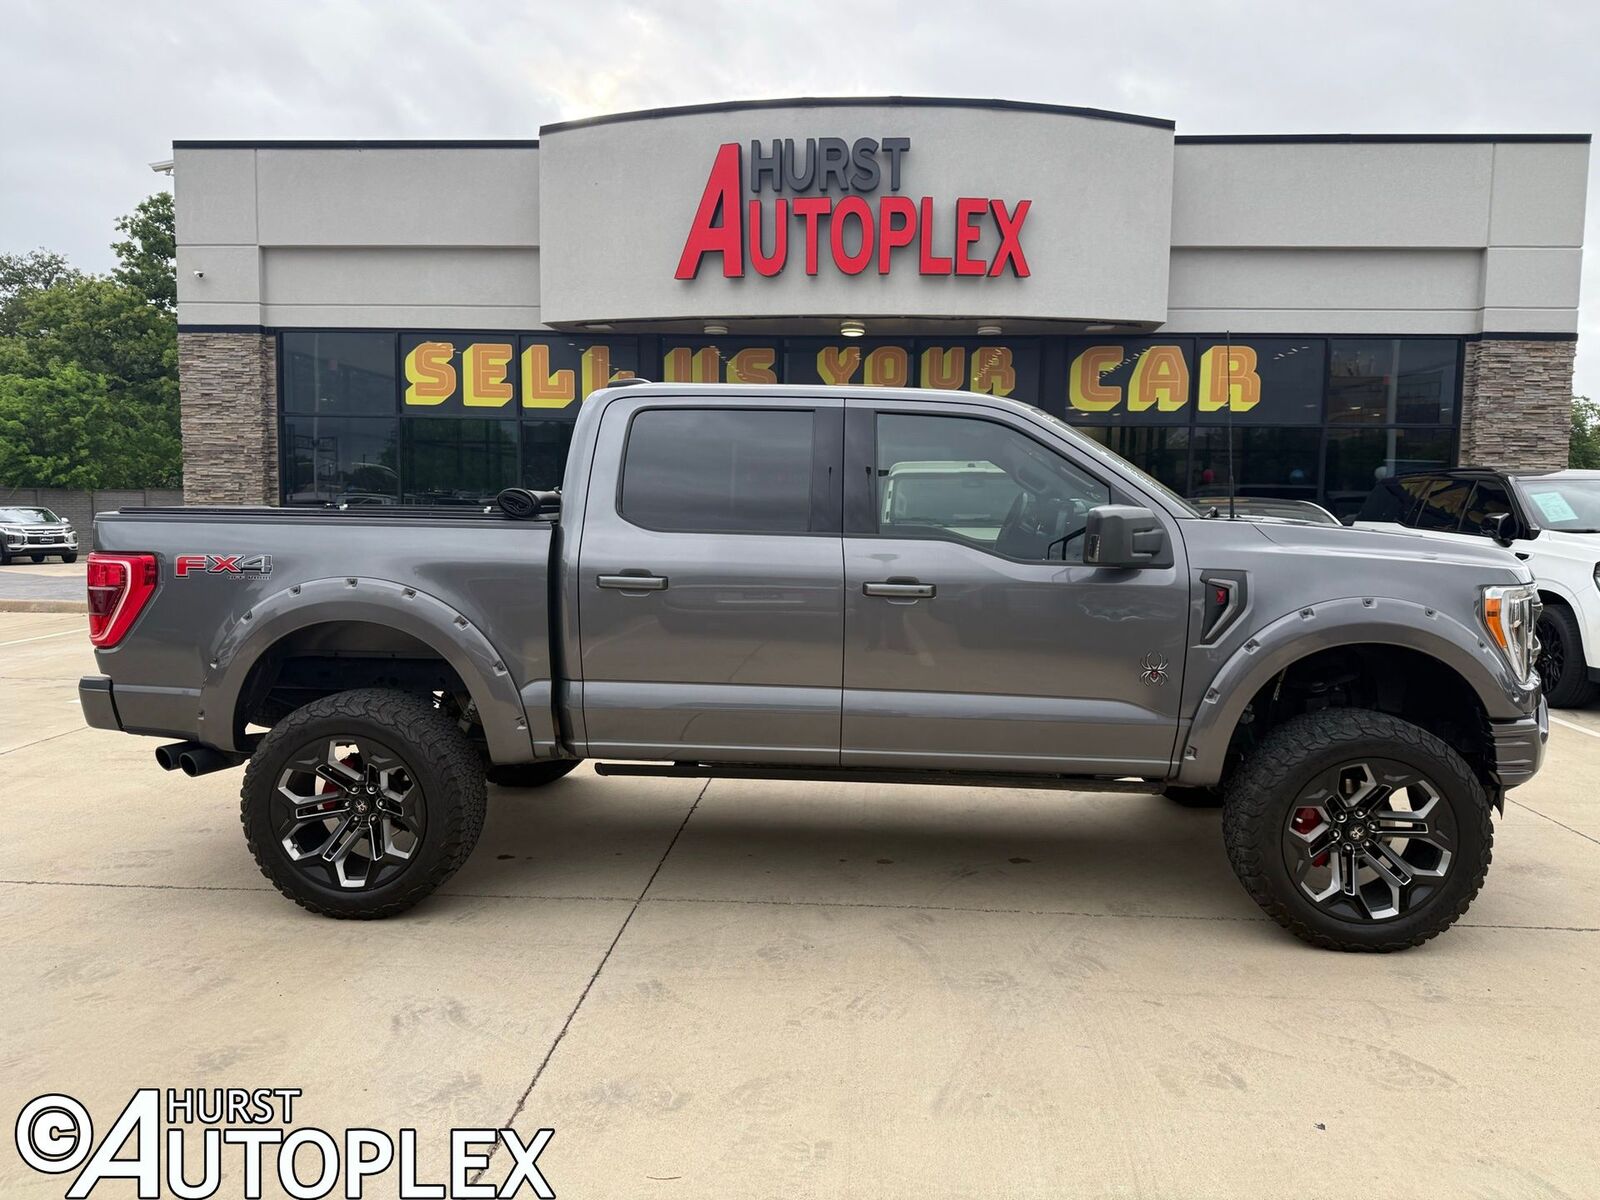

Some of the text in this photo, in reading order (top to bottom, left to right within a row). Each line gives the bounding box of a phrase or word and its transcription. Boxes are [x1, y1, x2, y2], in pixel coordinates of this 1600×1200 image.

[751, 137, 911, 193] HURST
[674, 142, 1032, 280] AUTOPLEX
[816, 345, 1017, 397] YOUR
[1068, 345, 1262, 412] CAR
[175, 554, 273, 579] FX4
